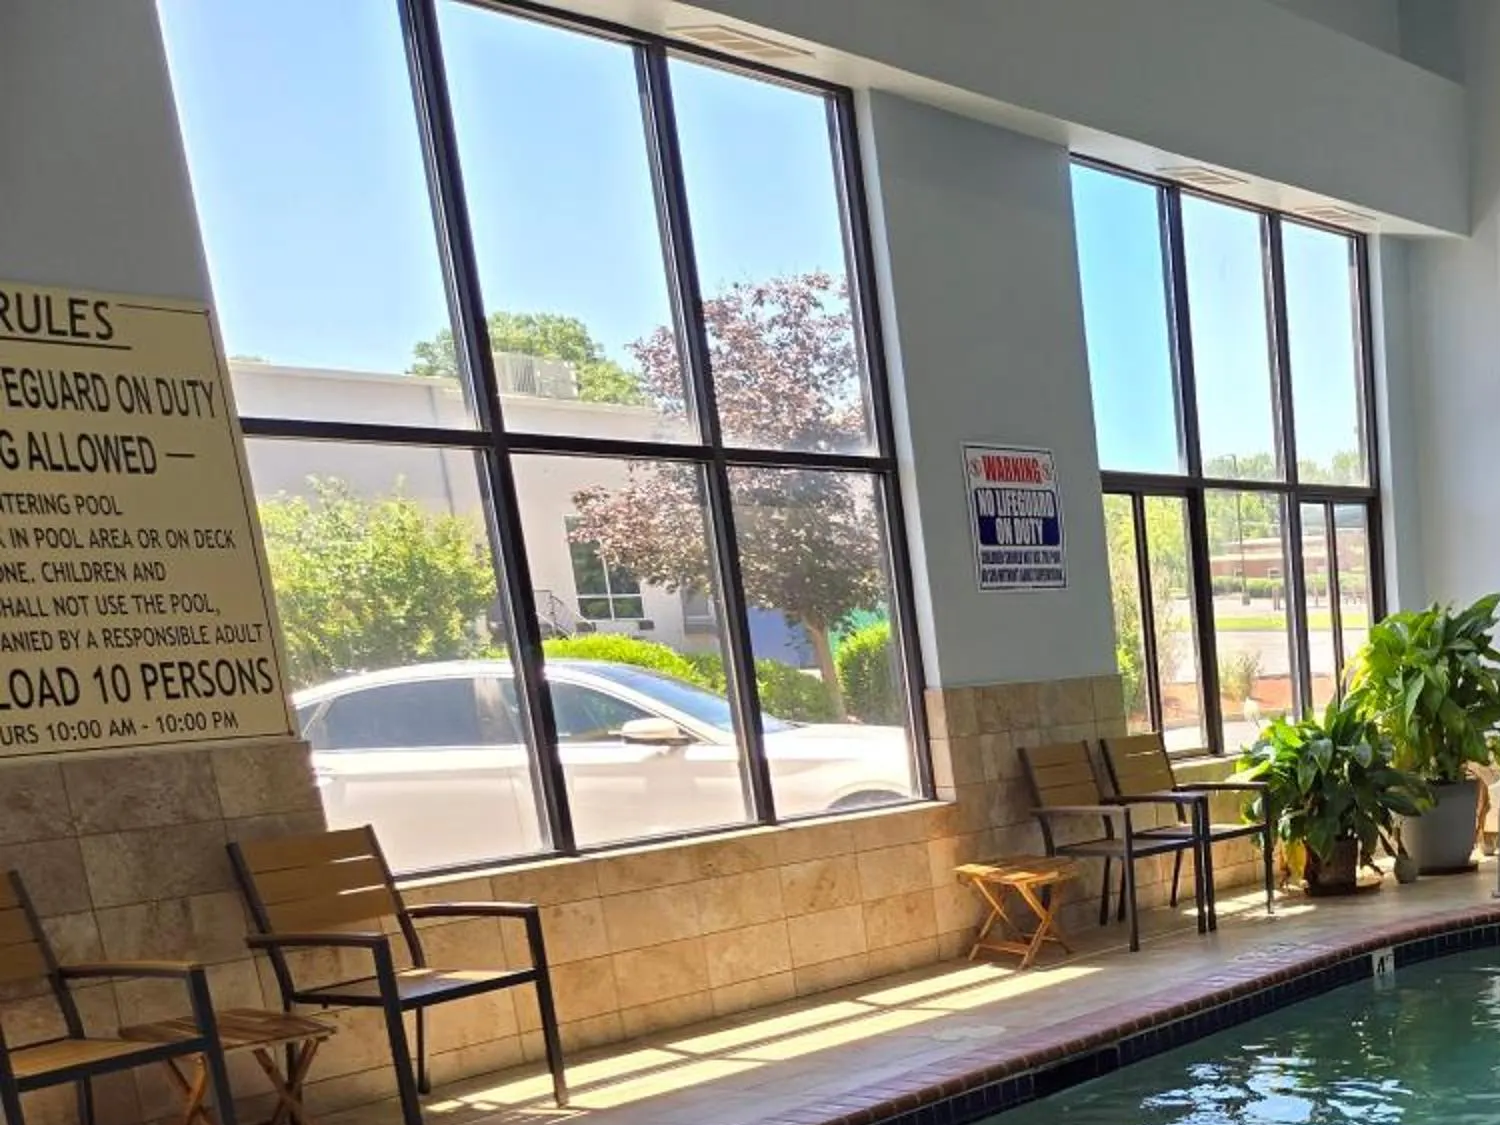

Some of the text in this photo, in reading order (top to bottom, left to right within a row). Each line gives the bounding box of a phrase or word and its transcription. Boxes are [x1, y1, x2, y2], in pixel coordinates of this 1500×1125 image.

[0, 367, 216, 419] EGUARD ON DUTY
[28, 431, 158, 476] ALLOWED
[982, 455, 1043, 485] WARNING
[76, 494, 124, 517] POOL
[977, 488, 1055, 518] NO LIFEGUARD
[8, 527, 30, 549] IN
[34, 527, 84, 550] POOL
[89, 528, 133, 549] AREA
[137, 529, 161, 549] OR
[165, 528, 190, 549] ON
[194, 528, 236, 550] DECK
[995, 517, 1044, 545] ON DUTY
[41, 561, 127, 583] CHILDREN
[133, 561, 167, 582] AND
[0, 593, 221, 618] HALL NOT USE THE POOL,
[59, 629, 87, 650] BY
[87, 629, 99, 649] A
[103, 625, 211, 648] RESPONSIBLE
[215, 623, 263, 645] ADULT
[93, 664, 132, 704] 10
[140, 657, 274, 701] PERSONS
[46, 719, 101, 743] 10:00
[109, 718, 137, 738] AM
[155, 711, 207, 735] 10:00
[212, 710, 239, 730] PM
